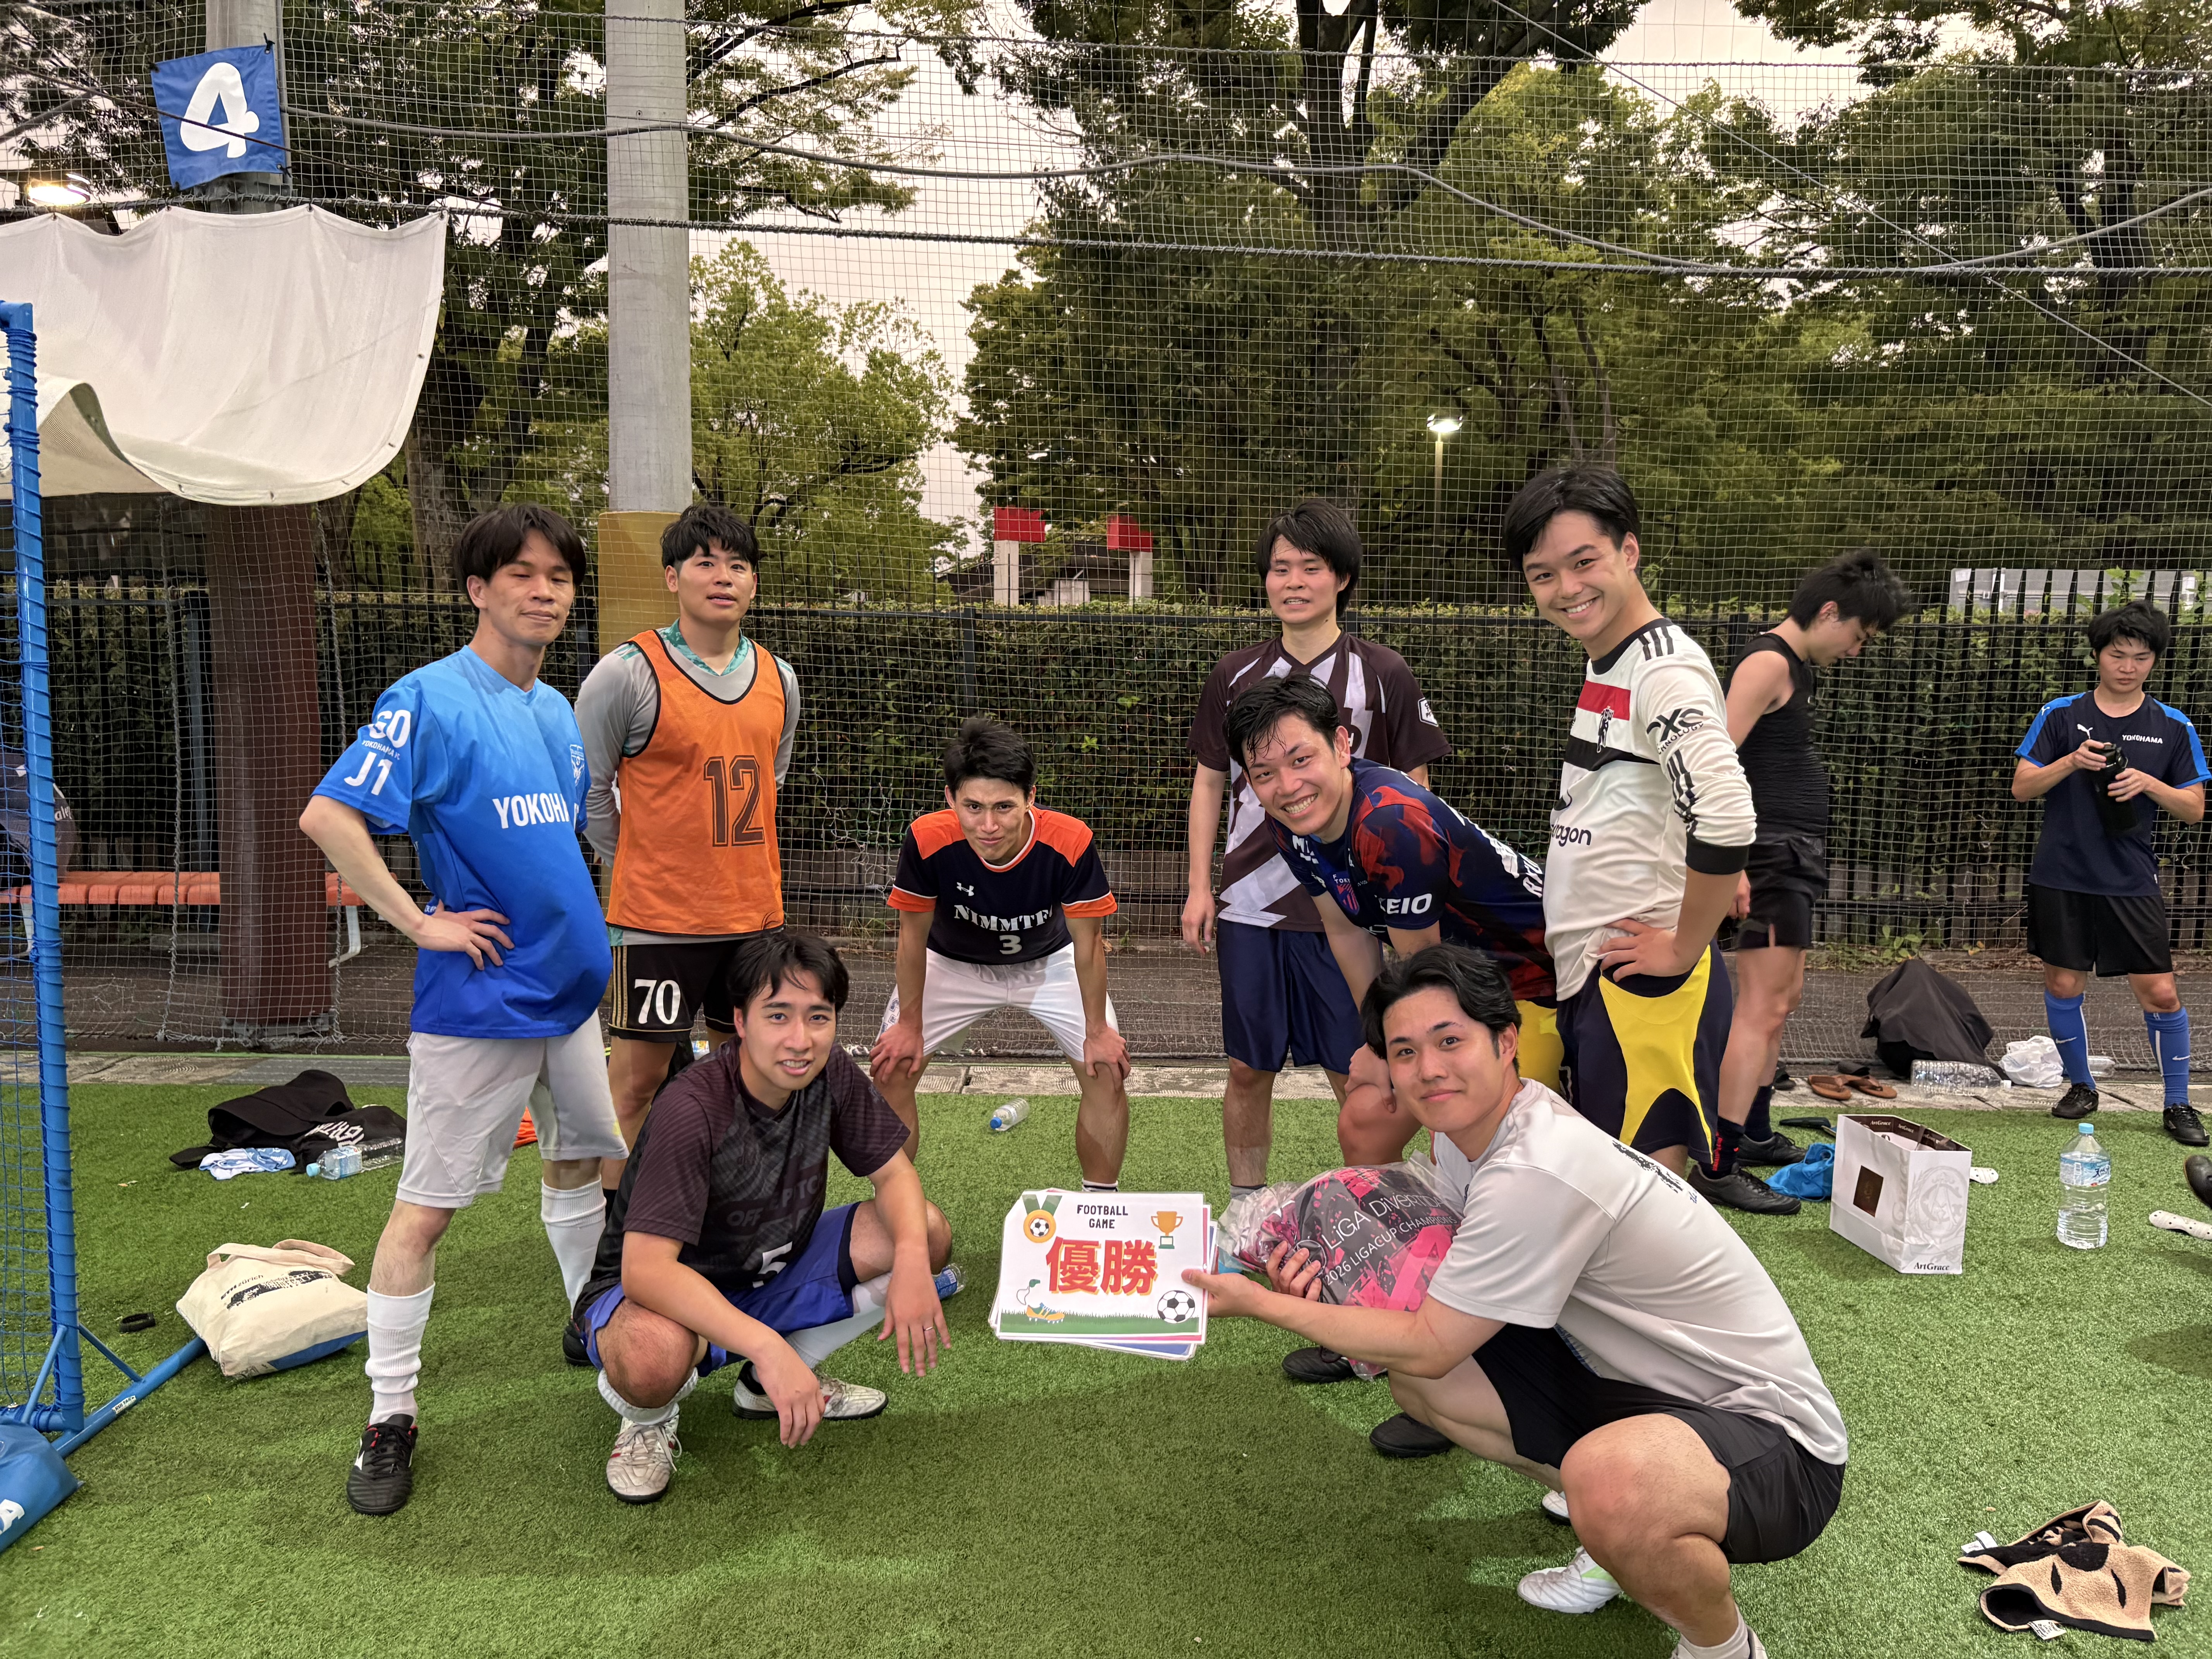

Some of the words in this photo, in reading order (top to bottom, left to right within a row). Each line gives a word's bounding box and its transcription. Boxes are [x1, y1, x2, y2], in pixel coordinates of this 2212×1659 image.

[180, 62, 259, 158] 4
[362, 740, 394, 757] YOKOHAMA
[2122, 734, 2163, 744] YOKOHAMA
[343, 751, 393, 796] J1
[704, 755, 765, 847] 12
[999, 934, 1022, 955] 3
[634, 979, 681, 1025] 70
[1077, 1204, 1128, 1216] FOOTBALL
[1089, 1219, 1115, 1229] GAME
[1046, 1236, 1158, 1296] 優勝
[1324, 1261, 1352, 1286] 2026
[1350, 1227, 1397, 1266] LIGACUP
[1399, 1216, 1457, 1233] CHAMPIONS
[1914, 1262, 1949, 1271] ArtGrace
